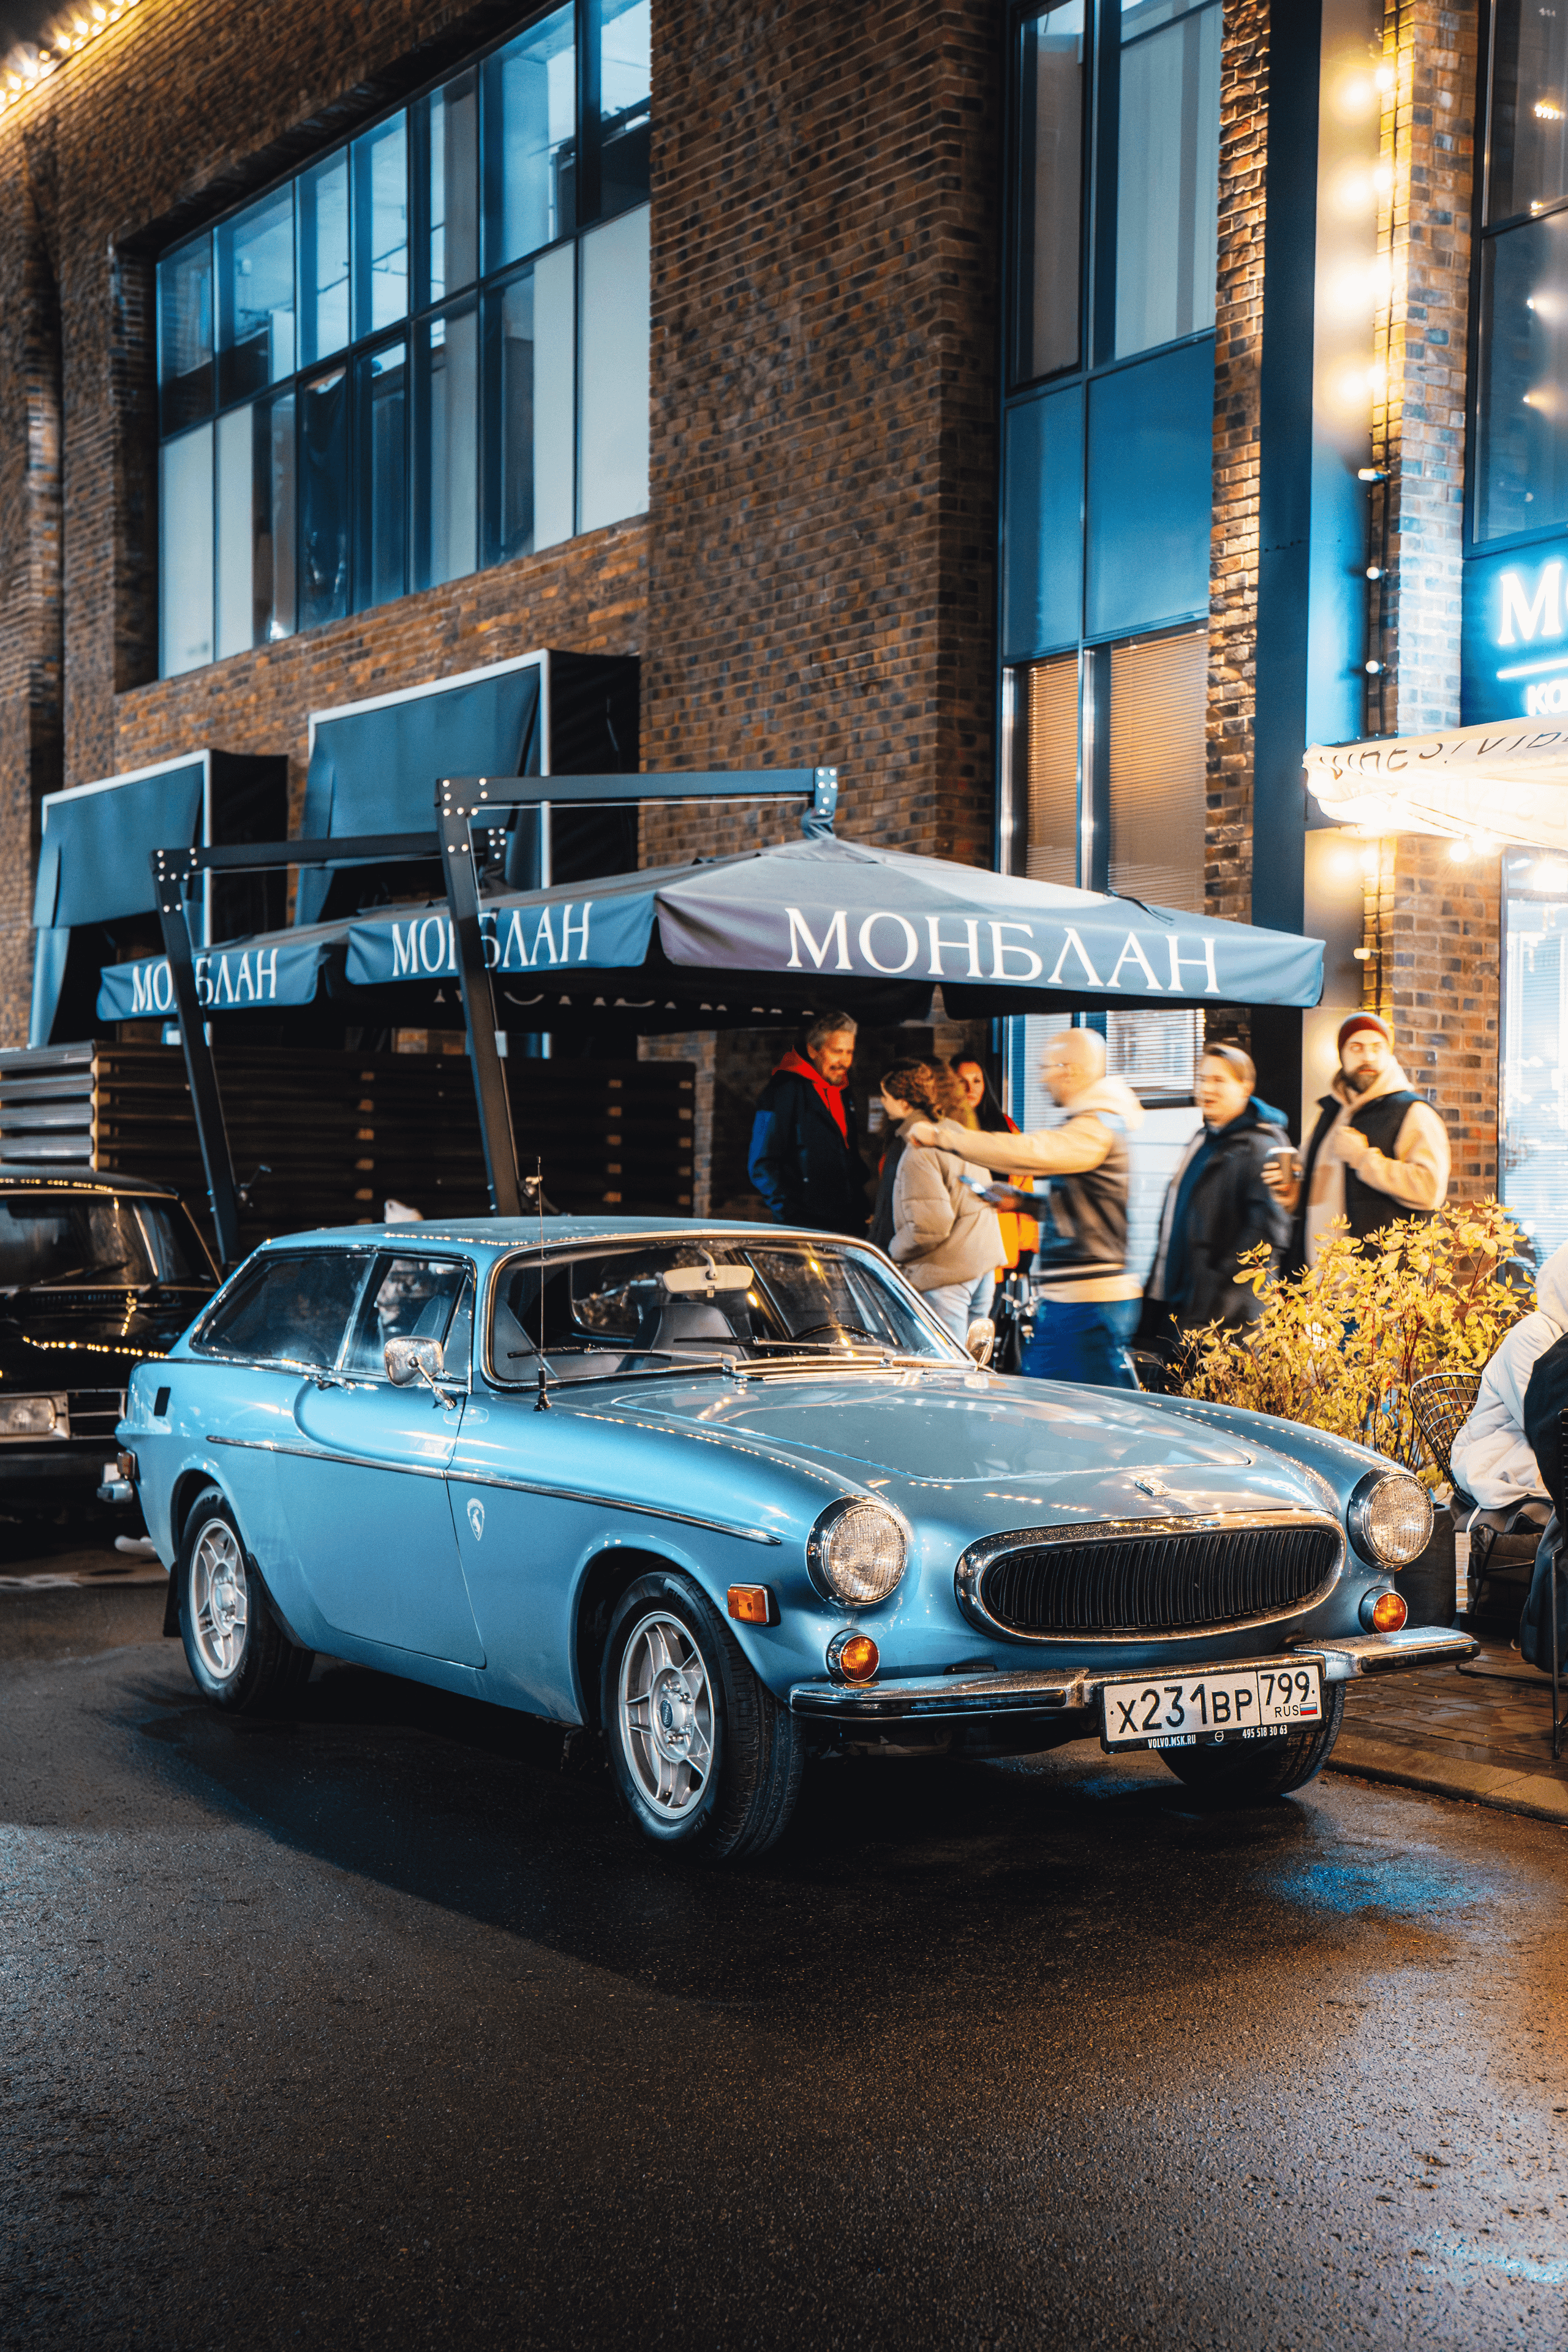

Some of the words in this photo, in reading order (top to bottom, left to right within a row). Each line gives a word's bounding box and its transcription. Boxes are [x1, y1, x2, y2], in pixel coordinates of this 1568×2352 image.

[785, 907, 1221, 993] МОНБЛАН
[131, 948, 279, 1012] МОБЛАН
[1260, 1671, 1310, 1706] 799
[1275, 1706, 1299, 1717] RUS
[1147, 1734, 1196, 1749] VOLVO.MSK.RU
[1242, 1728, 1255, 1739] 495
[1257, 1727, 1267, 1738] 518
[1270, 1726, 1277, 1736] 30
[1280, 1725, 1287, 1735] 63
